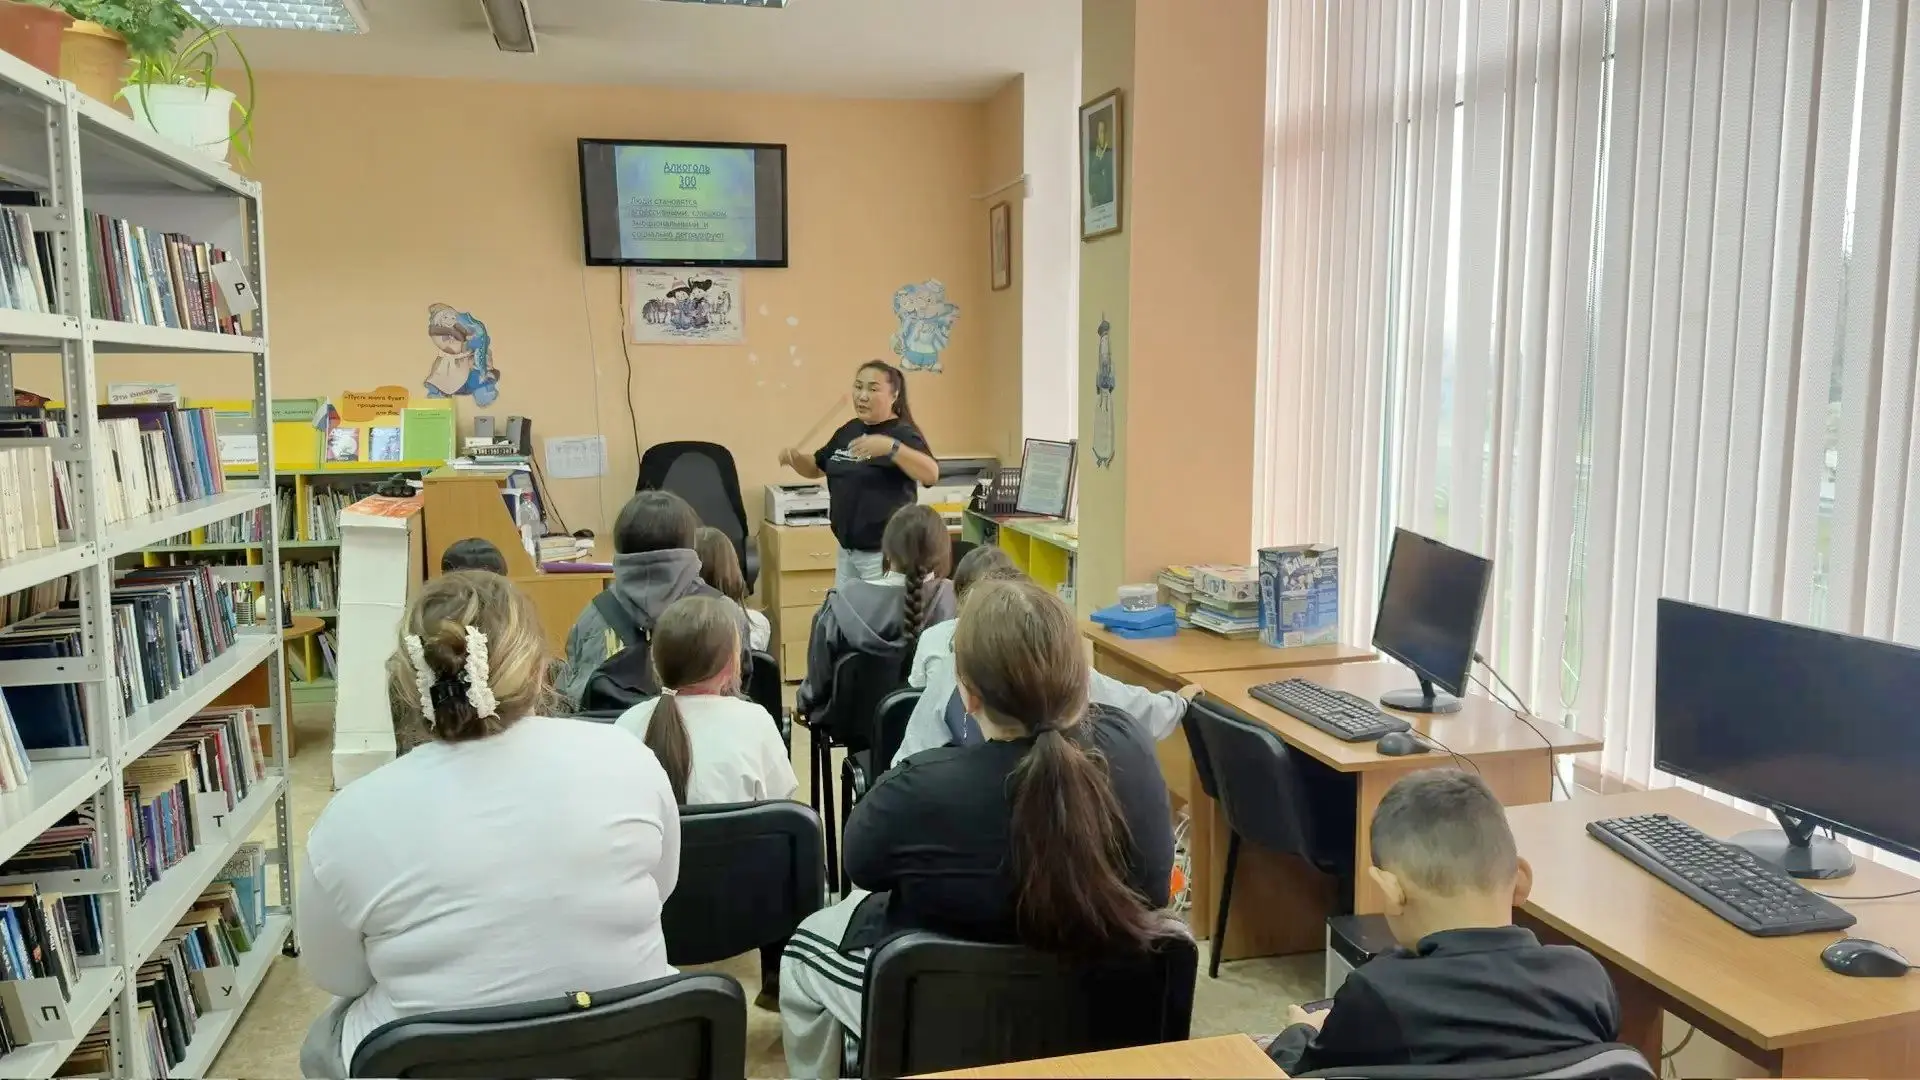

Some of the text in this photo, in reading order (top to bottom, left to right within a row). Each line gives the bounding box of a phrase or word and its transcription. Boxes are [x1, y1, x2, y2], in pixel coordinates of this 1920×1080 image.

[664, 161, 710, 174] Алкоголь
[679, 175, 697, 189] 300
[235, 282, 246, 295] Р
[213, 815, 224, 827] Т
[221, 985, 232, 996] У
[41, 1006, 60, 1021] П
